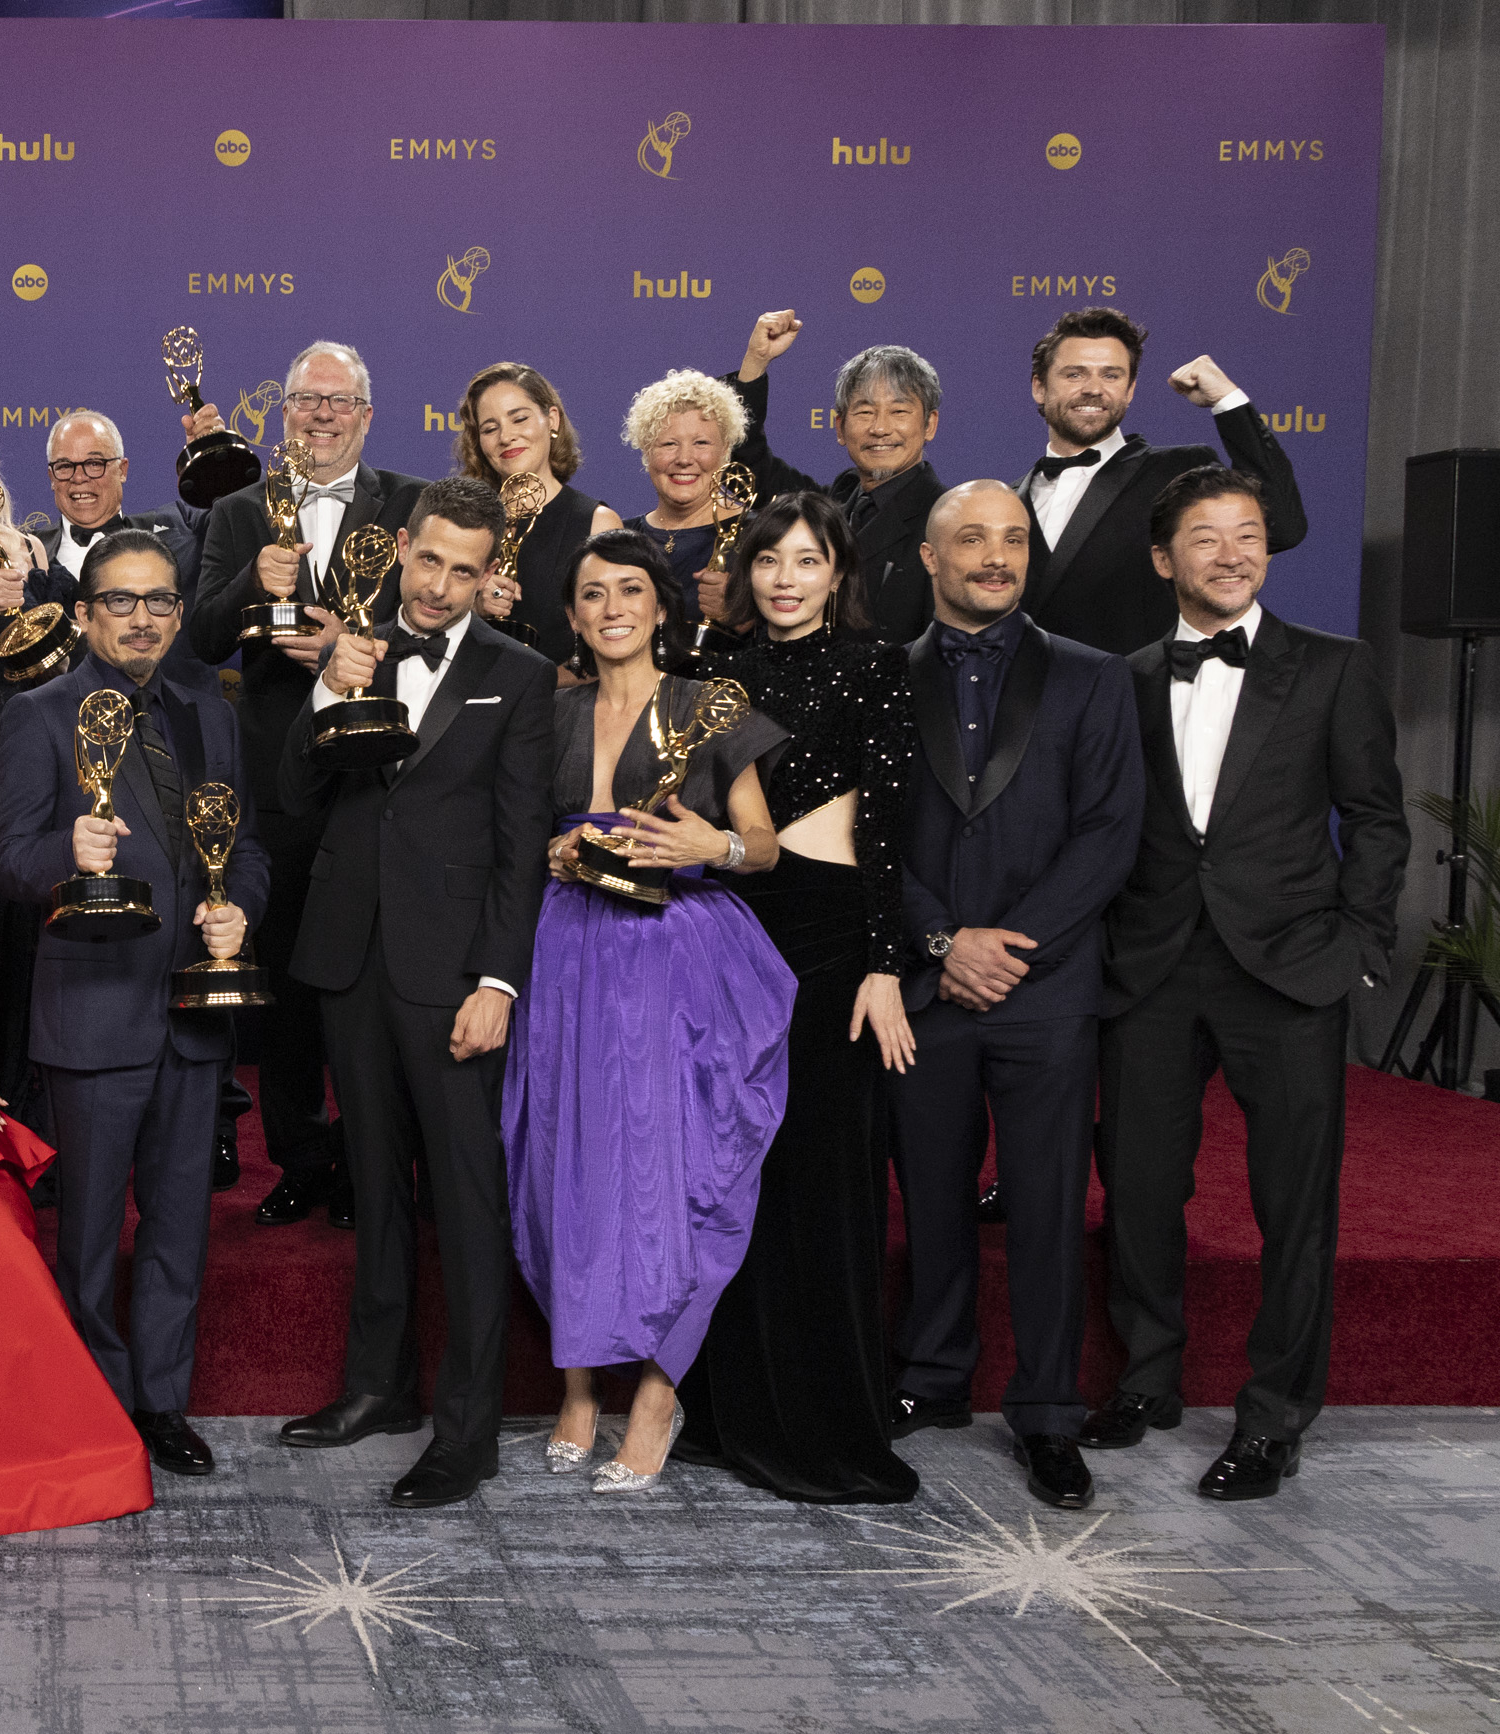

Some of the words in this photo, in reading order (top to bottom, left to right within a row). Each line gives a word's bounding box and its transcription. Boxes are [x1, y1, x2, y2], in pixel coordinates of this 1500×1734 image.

[218, 140, 249, 153] abc
[391, 139, 496, 160] EMMYS
[832, 137, 910, 164] hulu
[1049, 144, 1080, 157] abc
[1220, 140, 1323, 161] EMMYS
[15, 275, 46, 288] abc
[189, 273, 294, 294] EMMYS
[634, 271, 711, 298] hulu
[853, 278, 884, 291] abc
[1012, 276, 1116, 296] EMMYS
[424, 404, 465, 431] hu
